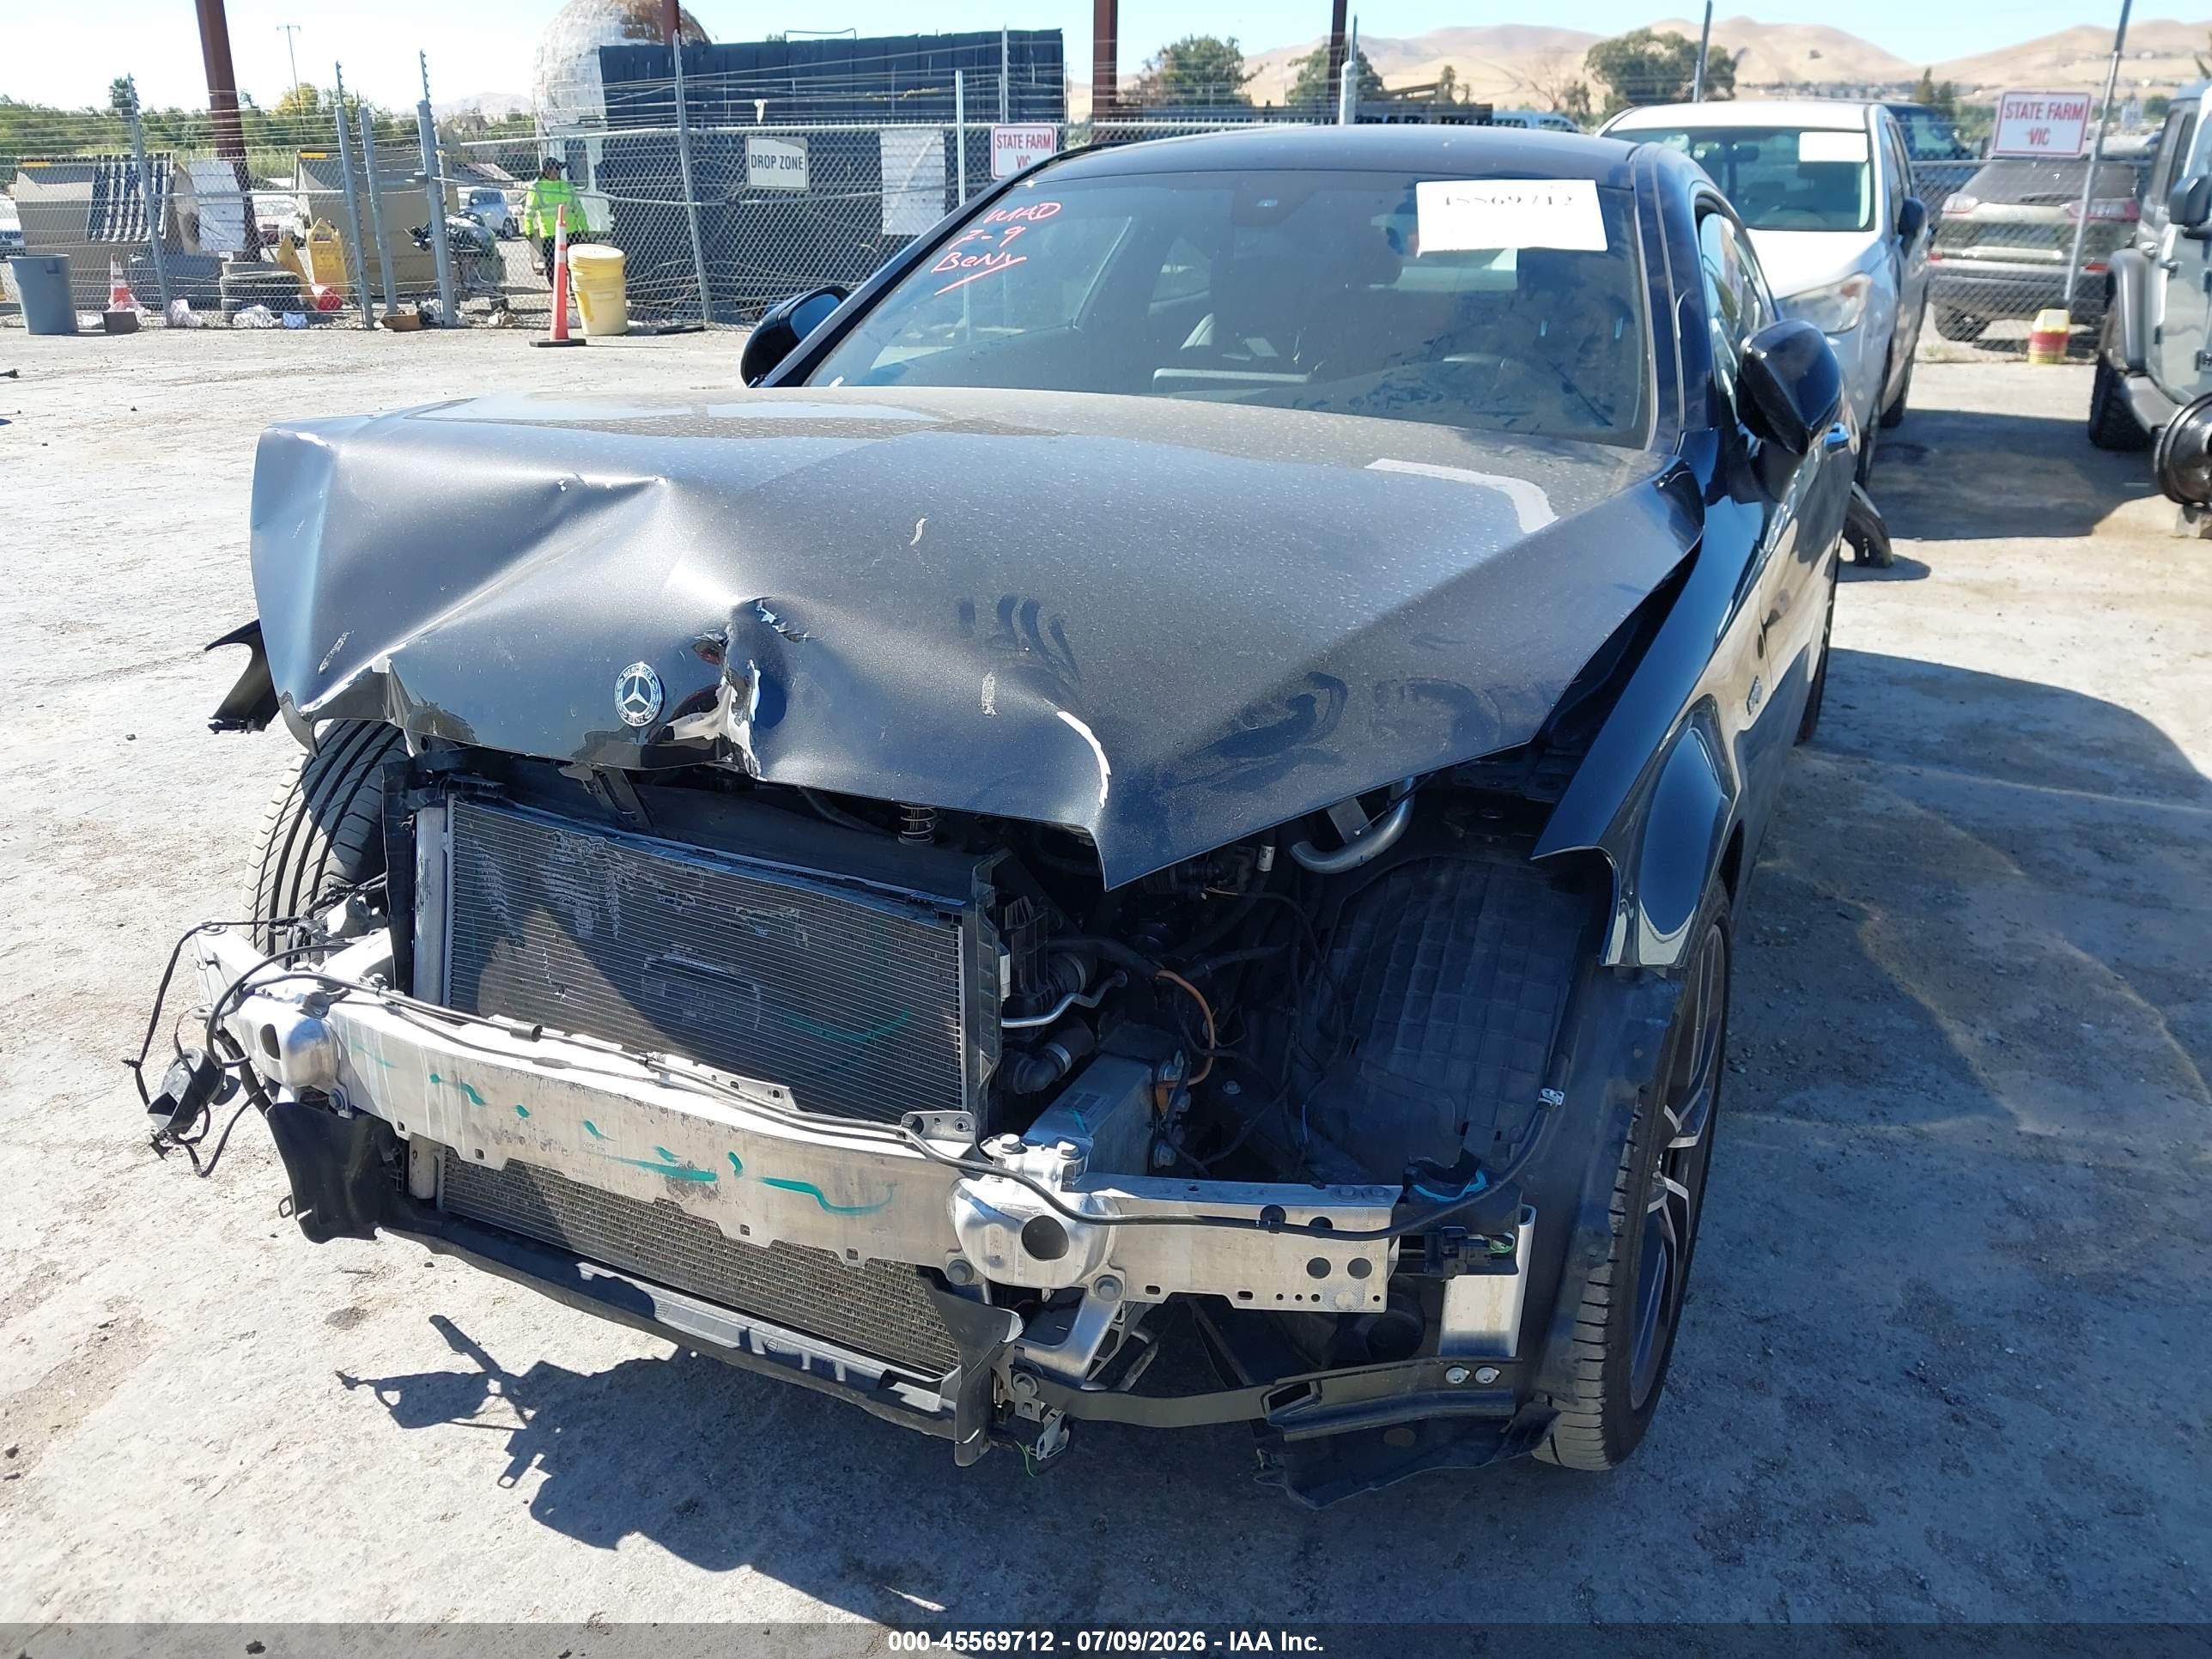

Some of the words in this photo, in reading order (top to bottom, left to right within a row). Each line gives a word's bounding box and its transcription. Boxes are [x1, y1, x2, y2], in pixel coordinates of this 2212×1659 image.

[2004, 102, 2043, 119] STATE
[2046, 102, 2084, 120] FARM
[996, 134, 1023, 149] STATE
[1026, 134, 1051, 149] FARM
[2029, 127, 2051, 144] VIC
[750, 155, 776, 169] DROP
[779, 155, 804, 170] ZONE
[623, 665, 653, 679] MERCDES
